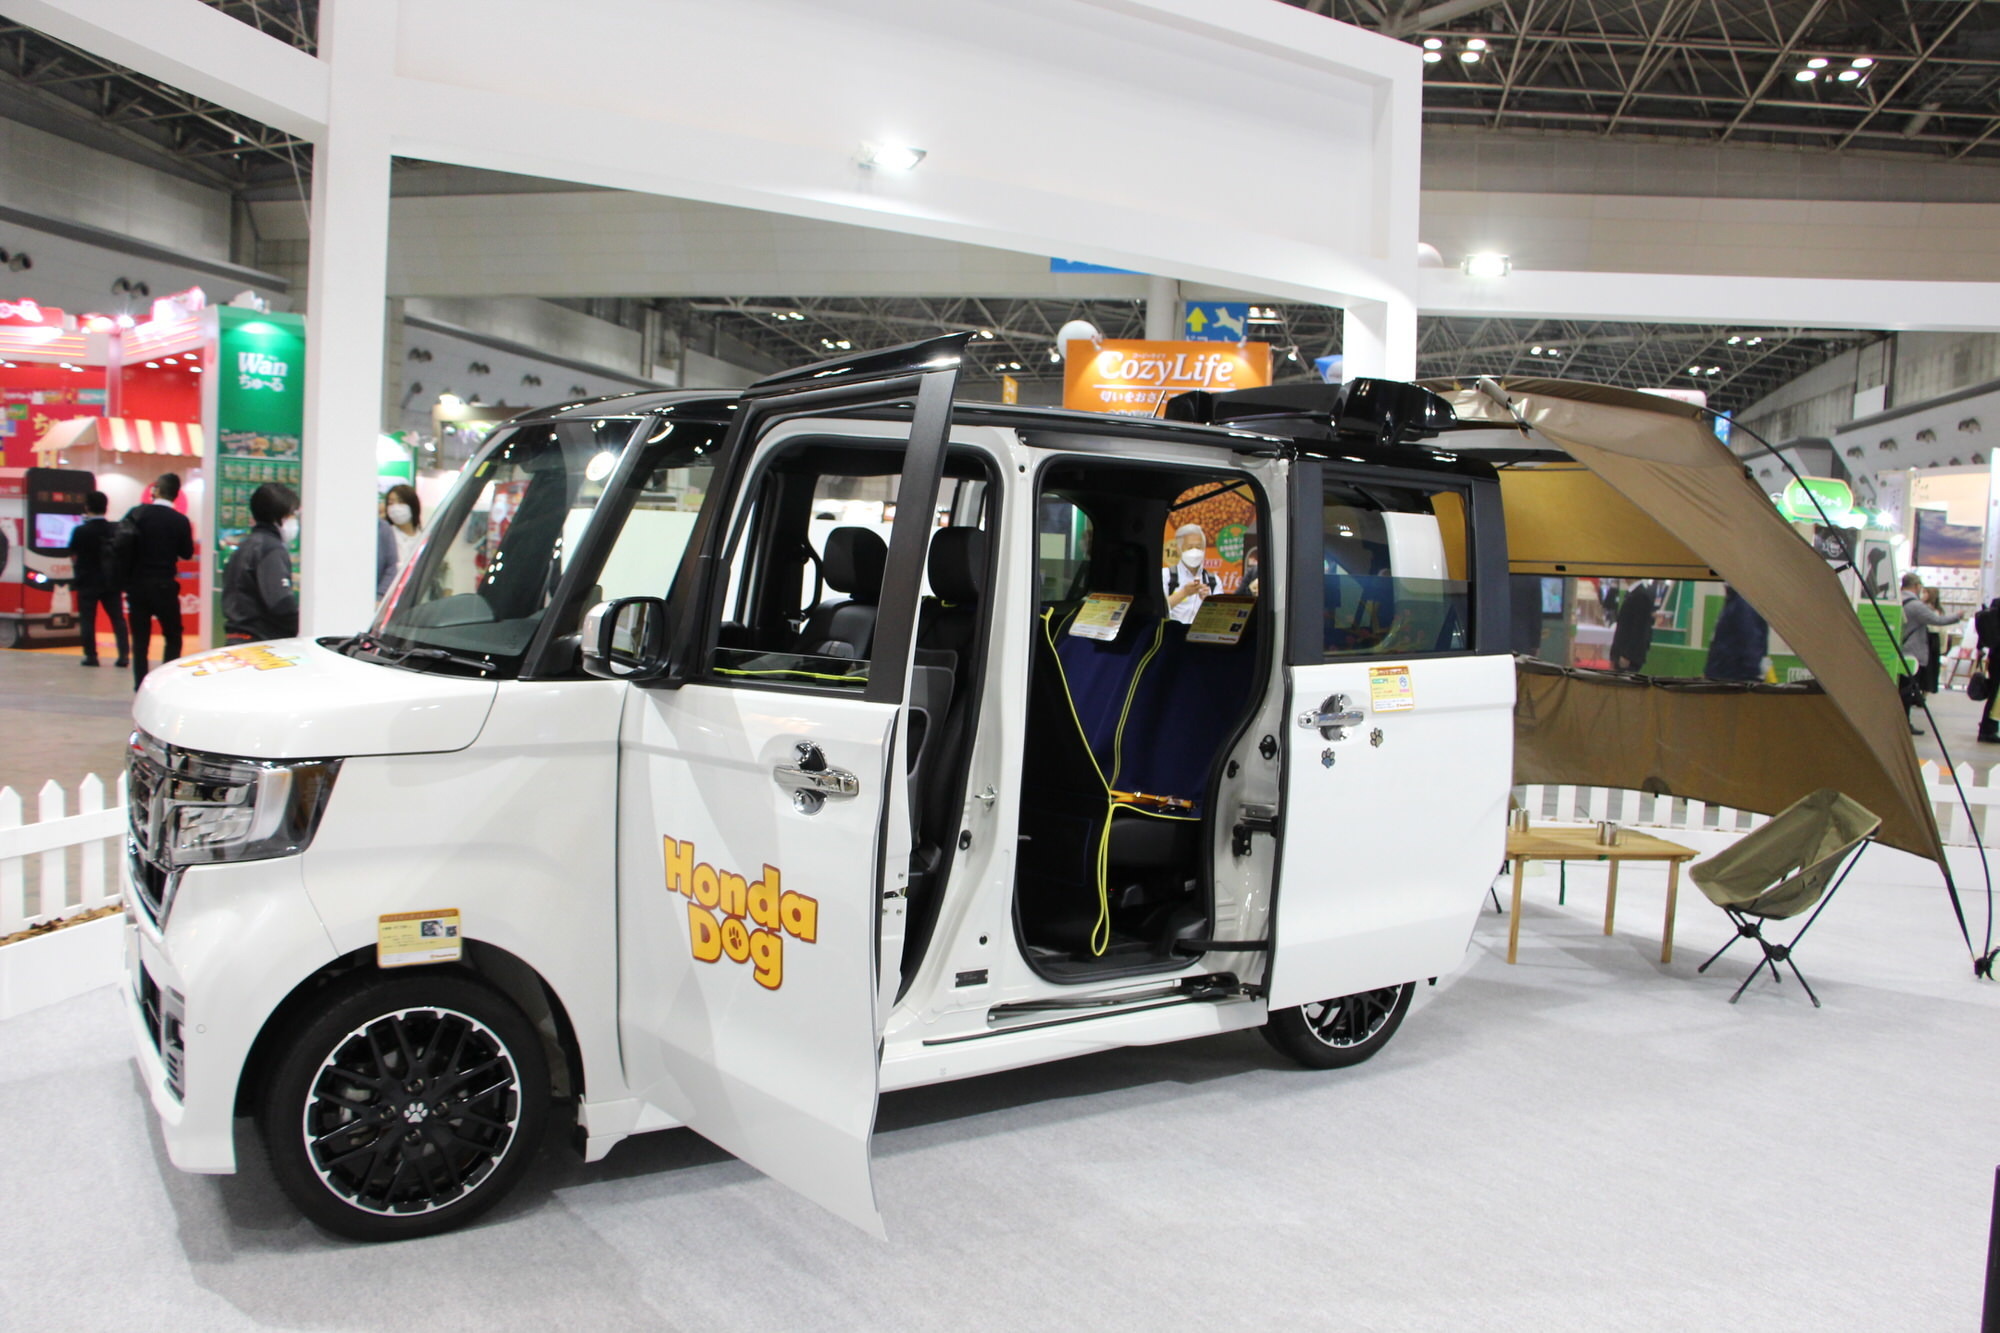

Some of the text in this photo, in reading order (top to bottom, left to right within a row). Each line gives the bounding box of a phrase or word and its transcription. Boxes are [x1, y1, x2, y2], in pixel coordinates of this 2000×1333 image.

[239, 352, 287, 376] Wan
[1098, 351, 1233, 387] CozyLife
[663, 834, 818, 944] Honda
[687, 900, 783, 991] Dog
